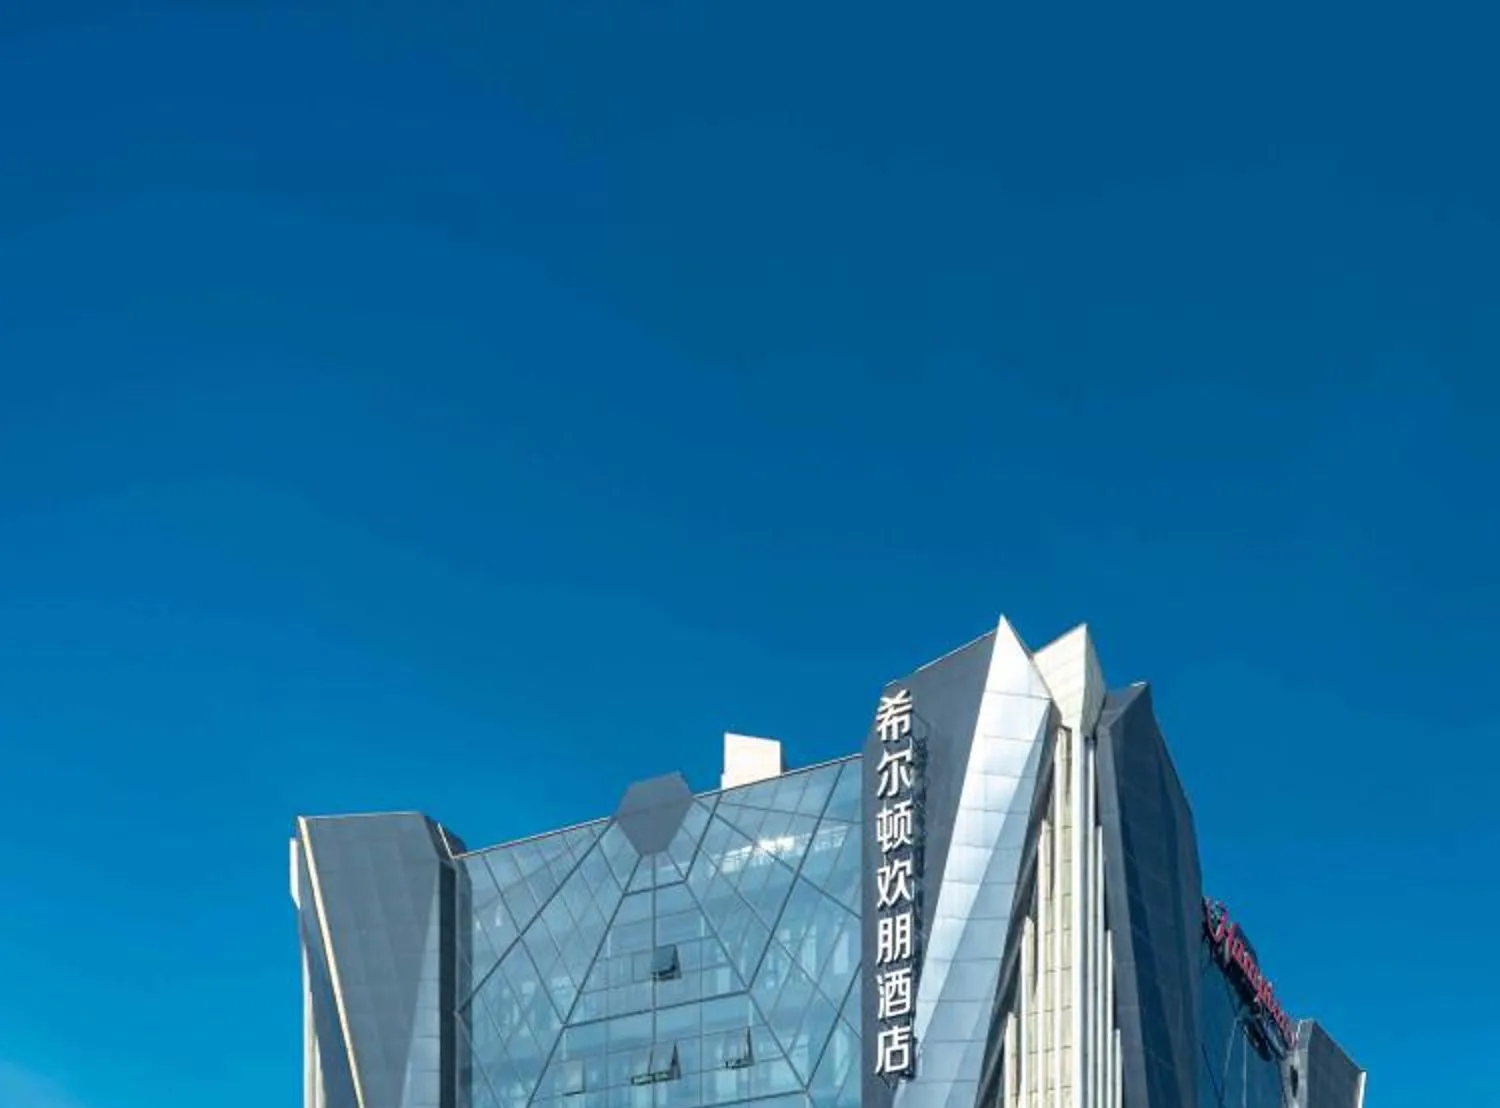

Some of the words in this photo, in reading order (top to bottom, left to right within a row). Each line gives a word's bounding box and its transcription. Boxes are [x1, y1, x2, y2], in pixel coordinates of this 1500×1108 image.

[875, 688, 915, 1075] 希尔顿欢朋酒店
